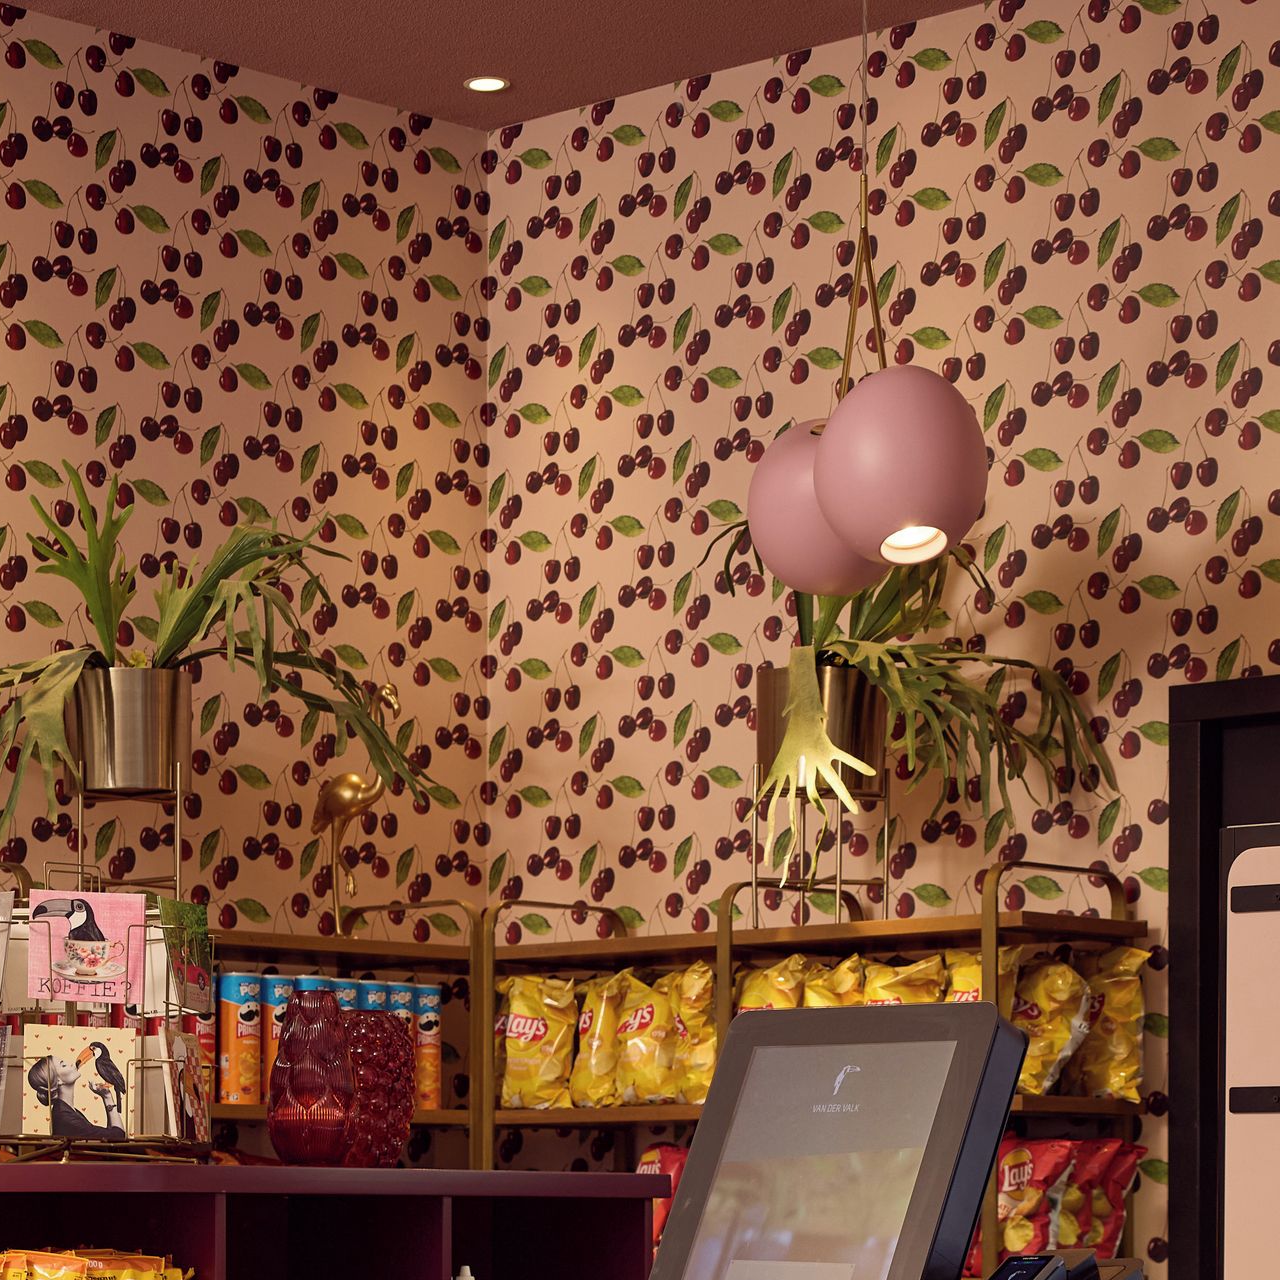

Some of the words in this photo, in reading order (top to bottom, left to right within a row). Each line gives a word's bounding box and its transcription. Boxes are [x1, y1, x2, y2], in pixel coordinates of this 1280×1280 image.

[506, 1013, 546, 1043] Lay's
[827, 1104, 841, 1113] DER
[1002, 1160, 1034, 1192] Lay's
